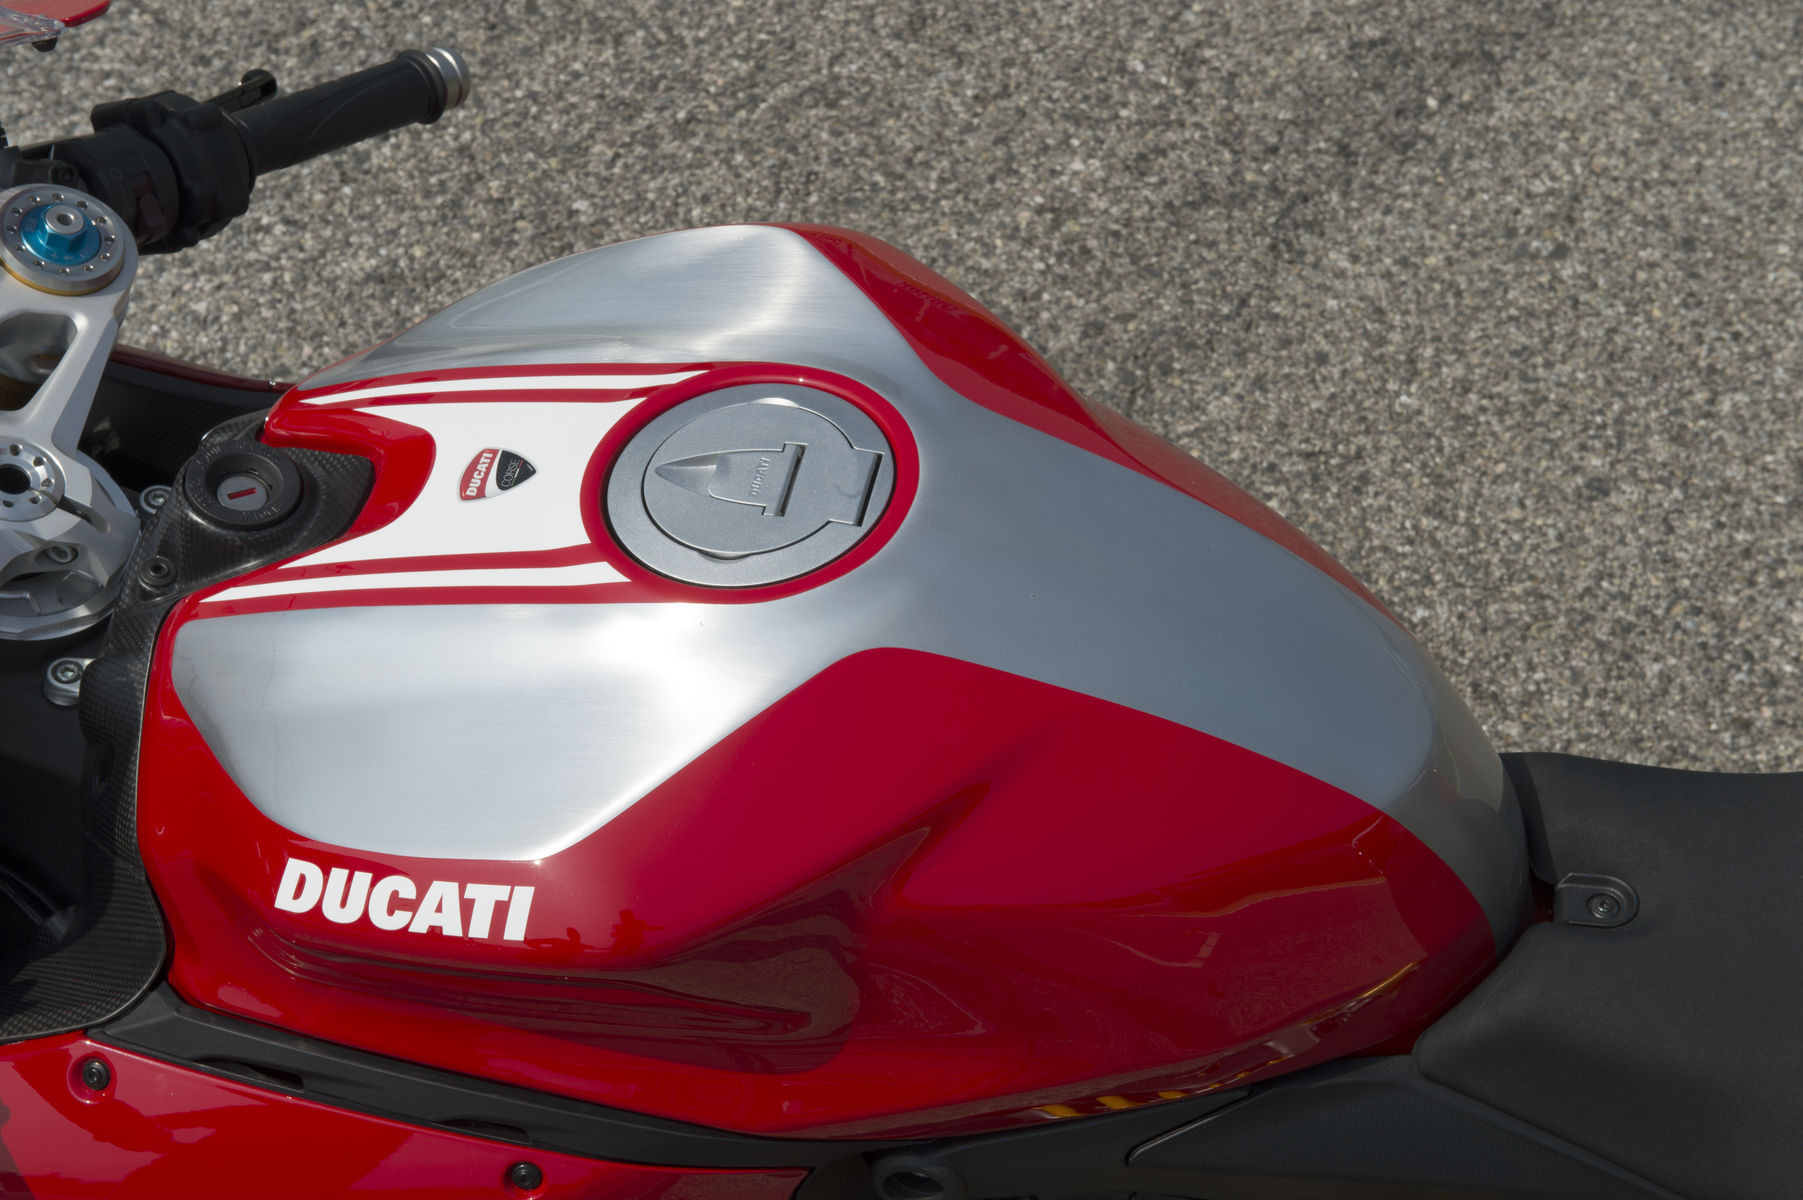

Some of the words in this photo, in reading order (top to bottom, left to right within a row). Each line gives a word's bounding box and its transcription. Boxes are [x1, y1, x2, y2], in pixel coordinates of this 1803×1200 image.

[465, 453, 493, 496] DUCATI
[501, 459, 520, 487] CORSE
[750, 457, 770, 495] DUCATI
[274, 857, 535, 941] DUCATI
